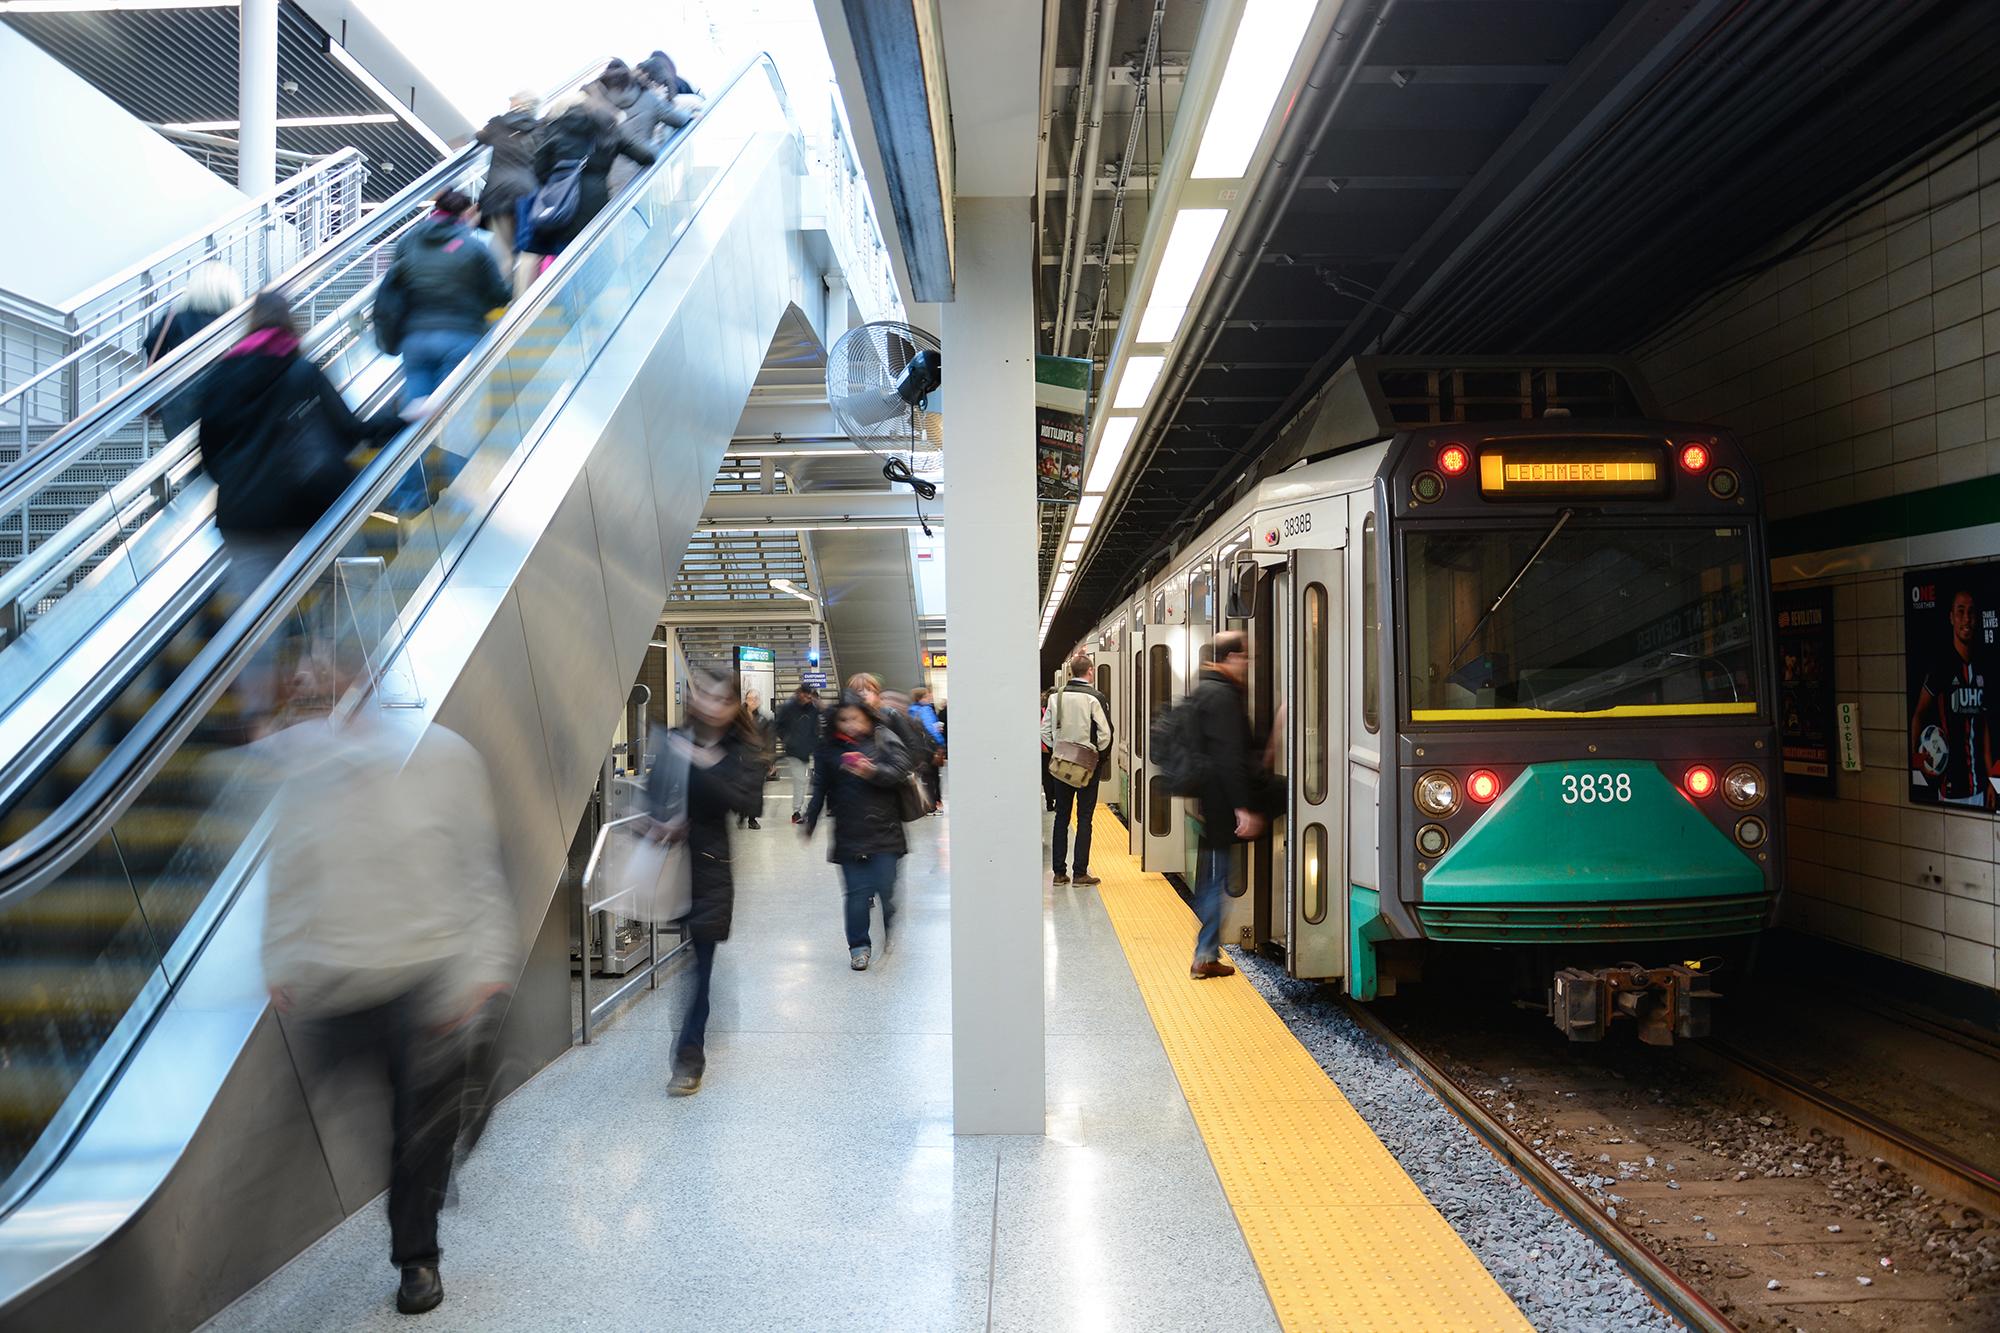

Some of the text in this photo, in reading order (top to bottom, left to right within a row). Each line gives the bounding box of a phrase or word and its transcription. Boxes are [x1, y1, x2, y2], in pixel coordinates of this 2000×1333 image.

[1507, 464, 1605, 480] LECHMERE
[1284, 513, 1312, 537] 3838B
[1912, 585, 1936, 602] ONE
[1562, 773, 1632, 804] 3838
